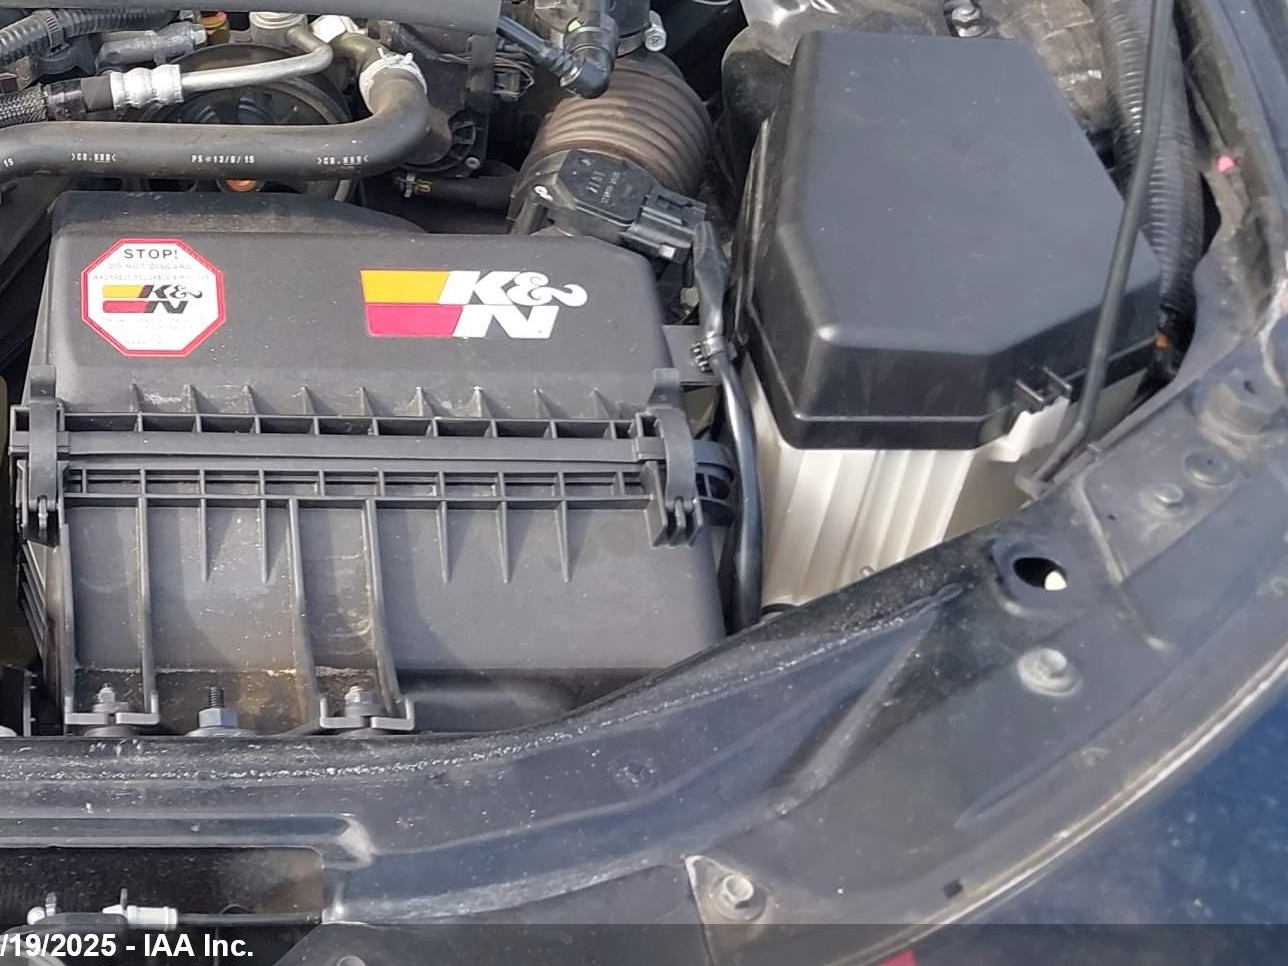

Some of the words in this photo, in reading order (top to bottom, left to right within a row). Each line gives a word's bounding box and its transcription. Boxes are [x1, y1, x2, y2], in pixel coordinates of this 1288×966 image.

[124, 249, 179, 260] STOP!
[137, 284, 203, 314] K&N
[439, 271, 589, 339] K&N
